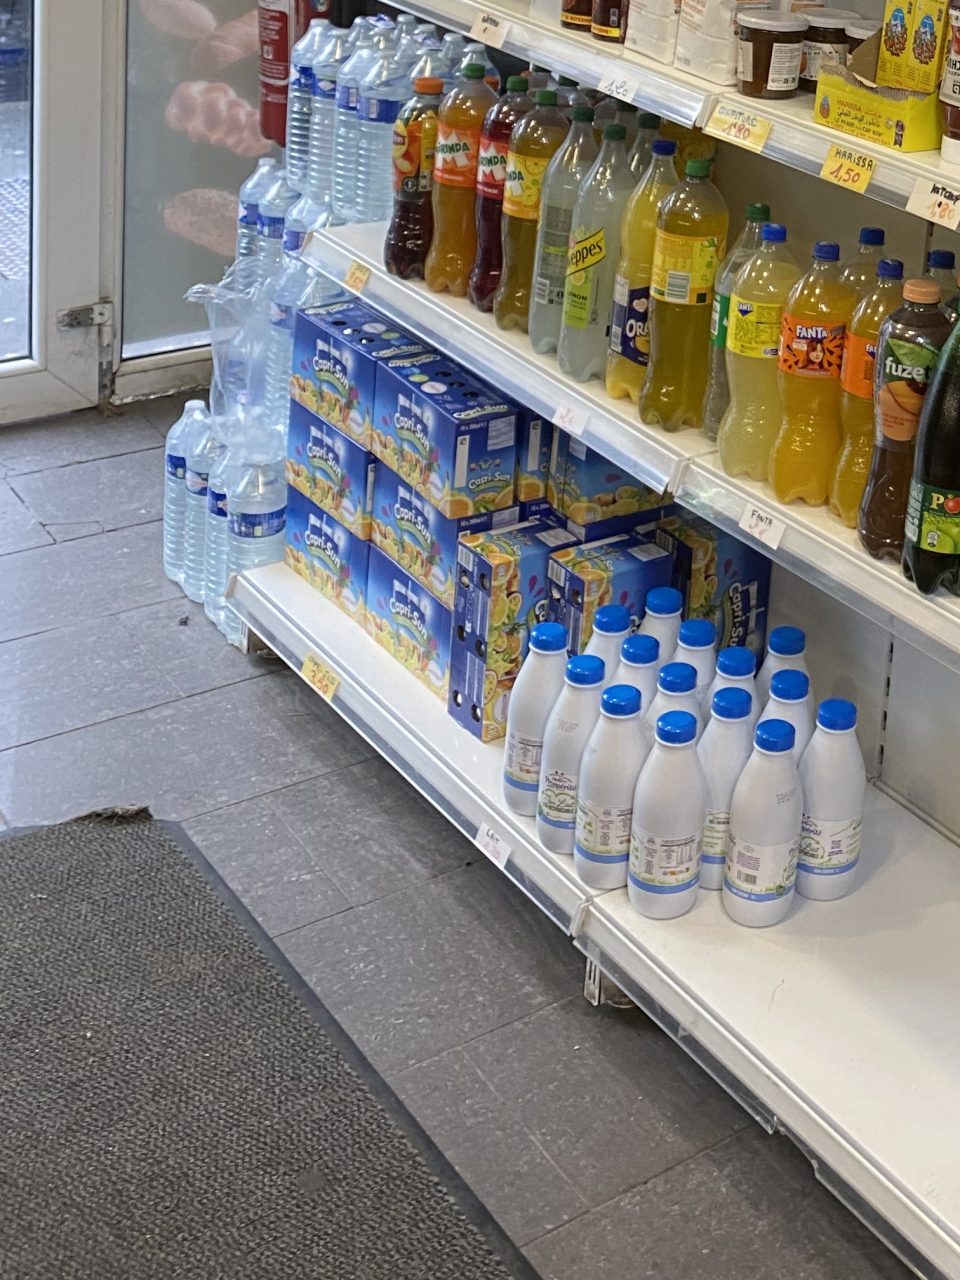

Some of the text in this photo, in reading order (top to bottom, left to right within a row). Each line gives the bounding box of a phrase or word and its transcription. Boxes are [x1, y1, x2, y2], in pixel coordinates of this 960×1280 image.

[829, 163, 861, 184] 1,50
[796, 324, 828, 339] FANTA
[312, 356, 350, 389] Capri-Sun
[453, 404, 508, 419] Capri-Sun
[393, 413, 431, 451] Capri-Sun
[306, 441, 342, 479] Capri-Sun
[468, 472, 512, 490] Capri-Sun
[393, 504, 432, 544] Capri-Sun
[304, 530, 341, 568] Capri-Sun
[389, 598, 428, 641] Capri-Sun
